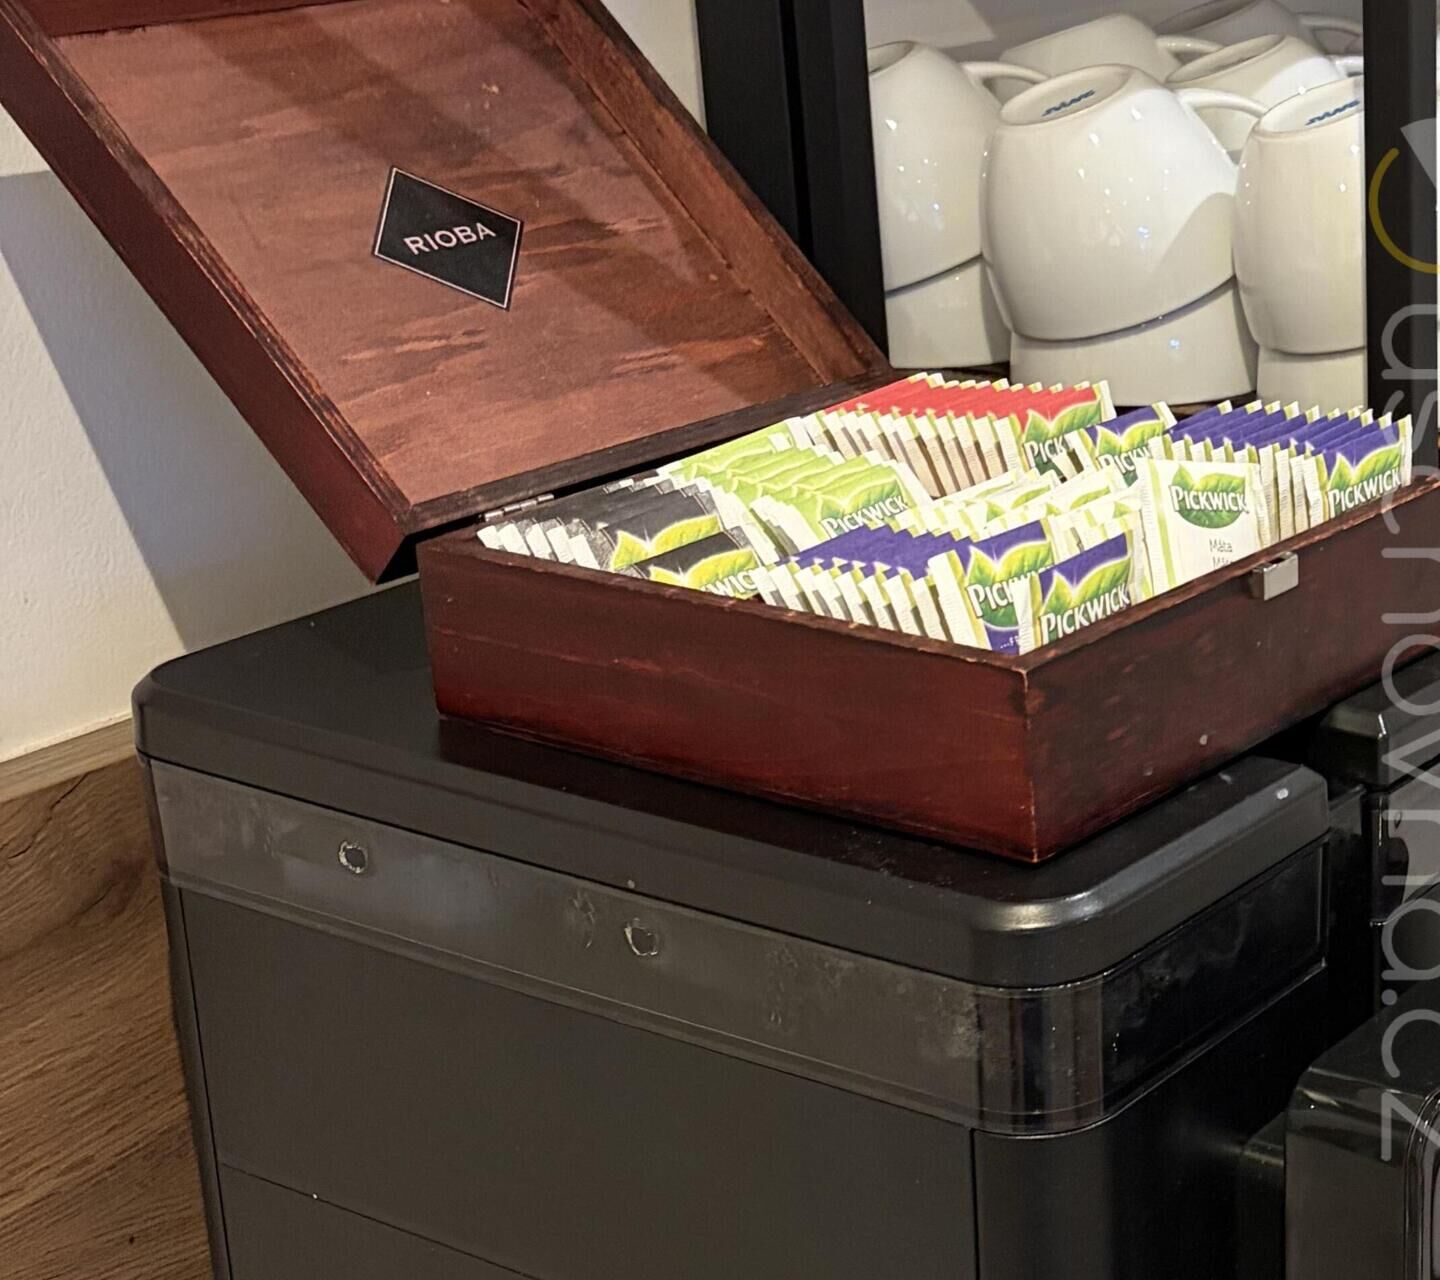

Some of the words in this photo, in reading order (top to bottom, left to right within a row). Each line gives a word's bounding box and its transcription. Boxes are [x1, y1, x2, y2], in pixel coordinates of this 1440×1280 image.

[404, 222, 496, 255] RIOBA
[1023, 436, 1065, 468] PICK
[1168, 484, 1249, 513] PICKWICK
[1327, 466, 1402, 519] PICKWICK
[819, 495, 909, 540] PICKWICK
[1039, 582, 1131, 646] PICKWICK
